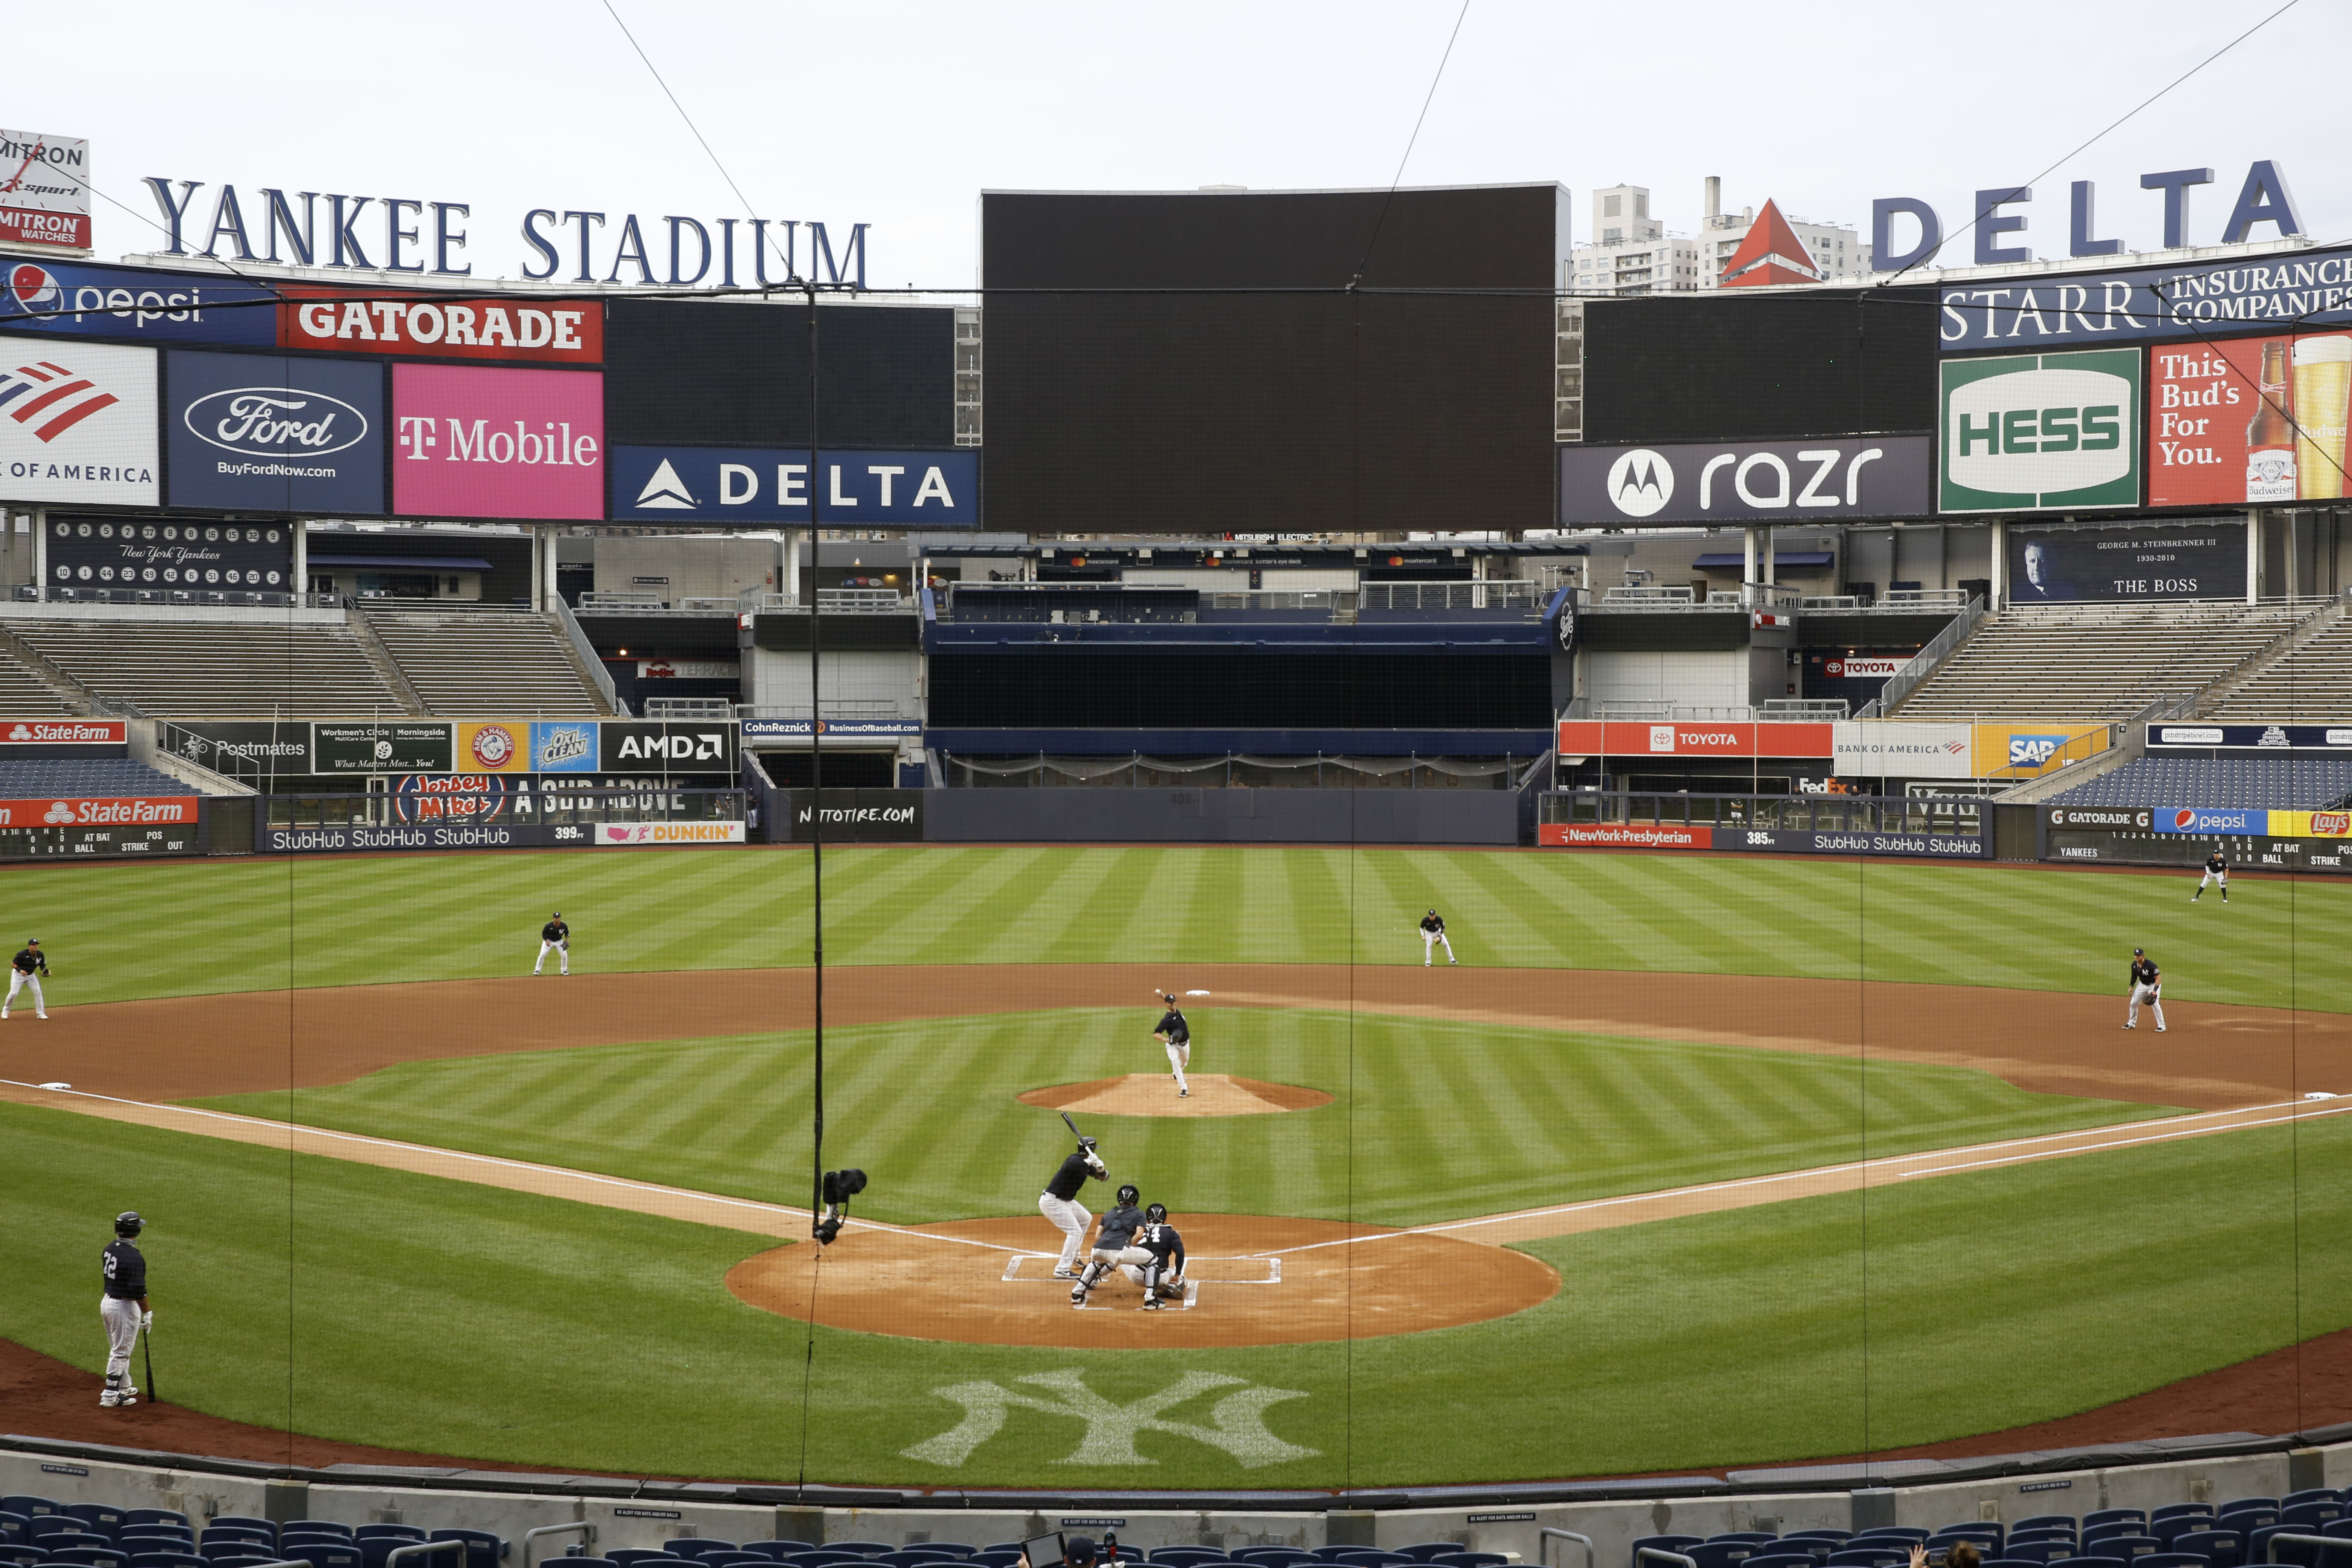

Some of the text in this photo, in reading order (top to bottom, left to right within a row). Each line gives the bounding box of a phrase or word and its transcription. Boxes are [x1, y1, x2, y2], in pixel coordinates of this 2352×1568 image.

[24, 184, 79, 195] sport
[1872, 160, 2307, 272] DELTA
[21, 229, 76, 243] WATCHES
[140, 177, 871, 291] YANKEE STADIUM
[76, 287, 200, 327] pepsi
[1940, 281, 2147, 341] STARR
[299, 301, 581, 349] GATORADE
[2160, 352, 2226, 379] This
[2160, 380, 2240, 408] Bud's
[218, 396, 336, 446] Ford
[2160, 413, 2209, 437] For
[1960, 405, 2119, 456] HESS
[400, 417, 597, 466] T Mobile
[2158, 441, 2222, 465] You.
[11, 463, 152, 483] OF AMERICA
[218, 462, 336, 477] BuyFordNow.com
[720, 463, 955, 507] DELTA
[1700, 448, 1883, 510] razr
[2249, 486, 2294, 495] Budweiser
[120, 545, 220, 564] New York Yankees
[2114, 579, 2197, 593] THE BOSS
[1846, 663, 1896, 672] TOYOTA
[746, 723, 811, 732] CohnReznick
[217, 741, 305, 755] Postmates
[474, 734, 484, 751] ARM
[489, 728, 512, 751] HAMMER
[553, 731, 577, 748] OXI
[618, 736, 693, 758] AMD
[1679, 733, 1737, 745] TOYOTA
[544, 740, 585, 762] CLEAN
[2010, 740, 2055, 762] SAP
[335, 760, 356, 768] What
[411, 775, 490, 793] Jersey
[1799, 778, 1848, 793] FedEx
[515, 780, 532, 813] A
[800, 806, 914, 824] NTTOTIRE.COM
[2068, 812, 2130, 824] GATORADE
[2200, 814, 2244, 830] pepsi
[2313, 813, 2348, 835] Lay's
[84, 833, 111, 842] AT BAT
[147, 831, 162, 840] POS
[273, 828, 510, 849] StubHub StubHub StubHub
[555, 826, 577, 839] 399
[654, 825, 734, 840] DUNKIN'
[1570, 829, 1691, 846] NewYork-Presbyterian
[1747, 832, 1768, 844] 385
[75, 841, 183, 853] BALL STRIKE OUT
[1815, 835, 1980, 853] StubHub StubHub StubHub
[2061, 848, 2097, 857] YANKEES
[2272, 844, 2300, 853] AT BAT
[2263, 854, 2340, 866] BALL STRIKE
[103, 1251, 117, 1279] 72
